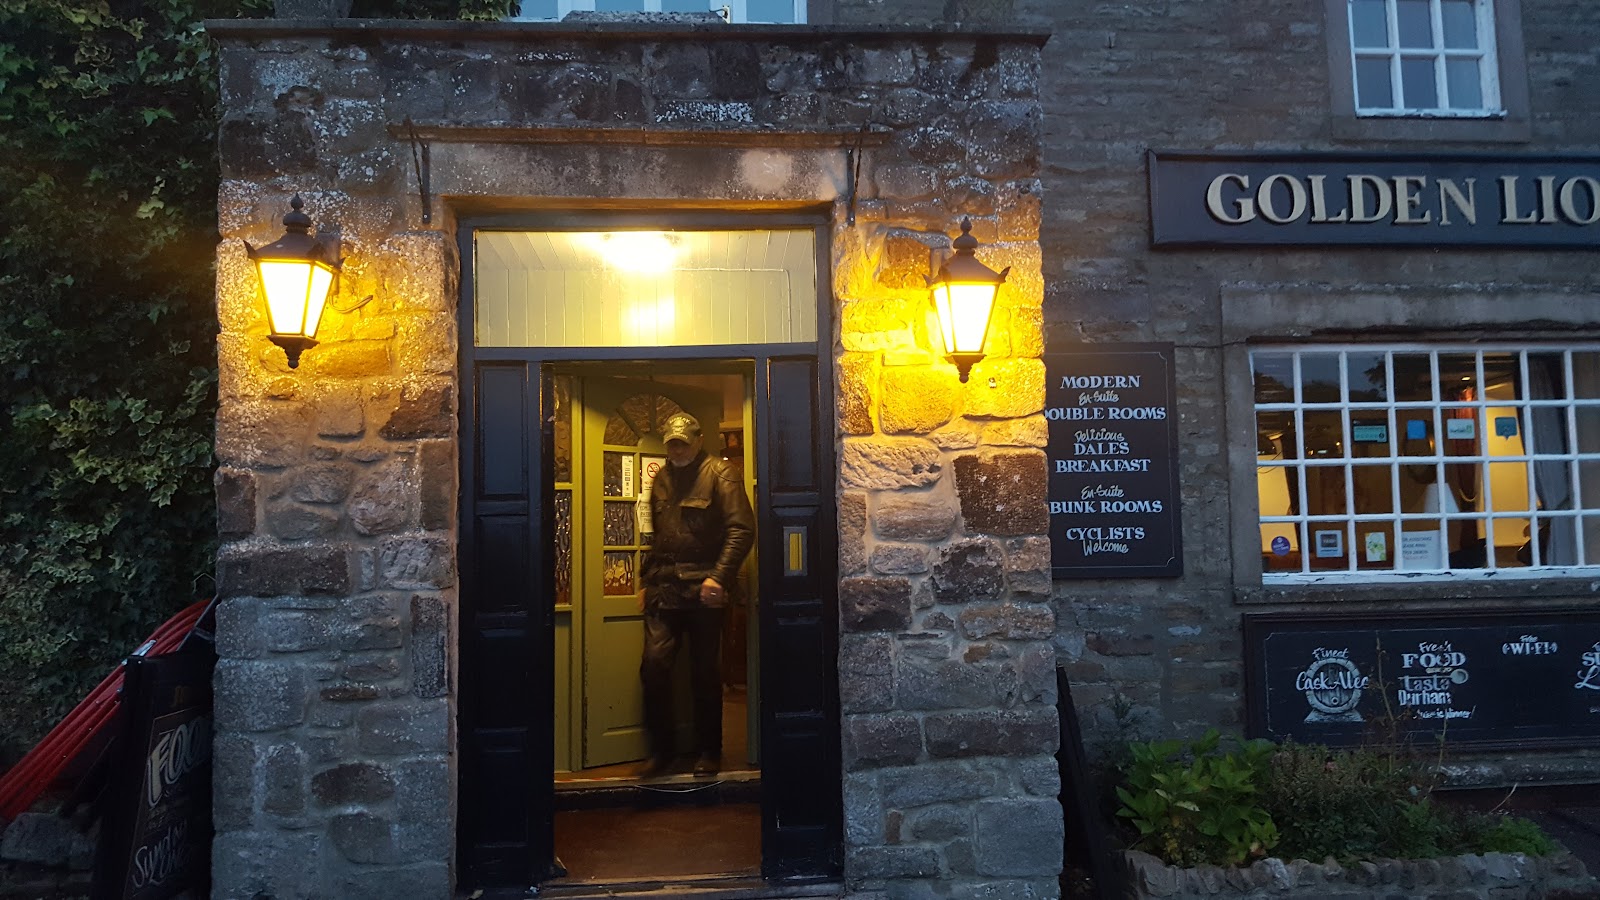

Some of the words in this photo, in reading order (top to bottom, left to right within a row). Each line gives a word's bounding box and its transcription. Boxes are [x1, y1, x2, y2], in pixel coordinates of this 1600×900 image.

[1206, 173, 1477, 226] GOLDEN
[1500, 175, 1600, 225] LIO
[1060, 375, 1141, 390] MODERN
[1078, 390, 1120, 406] En-Suite
[1045, 407, 1105, 421] OUBLE
[1108, 407, 1167, 420] ROOMS
[1074, 427, 1125, 443] Delicious
[1073, 442, 1130, 456] DALES
[1055, 459, 1151, 473] BREAKFAST
[1080, 484, 1125, 500] En-Suite
[1050, 500, 1097, 514] BUNK
[1100, 500, 1163, 514] ROOMS
[1066, 527, 1146, 541] CYCLISTS
[1082, 540, 1129, 556] Welcome
[1401, 652, 1467, 669] FOOD
[1296, 671, 1331, 691] Cask
